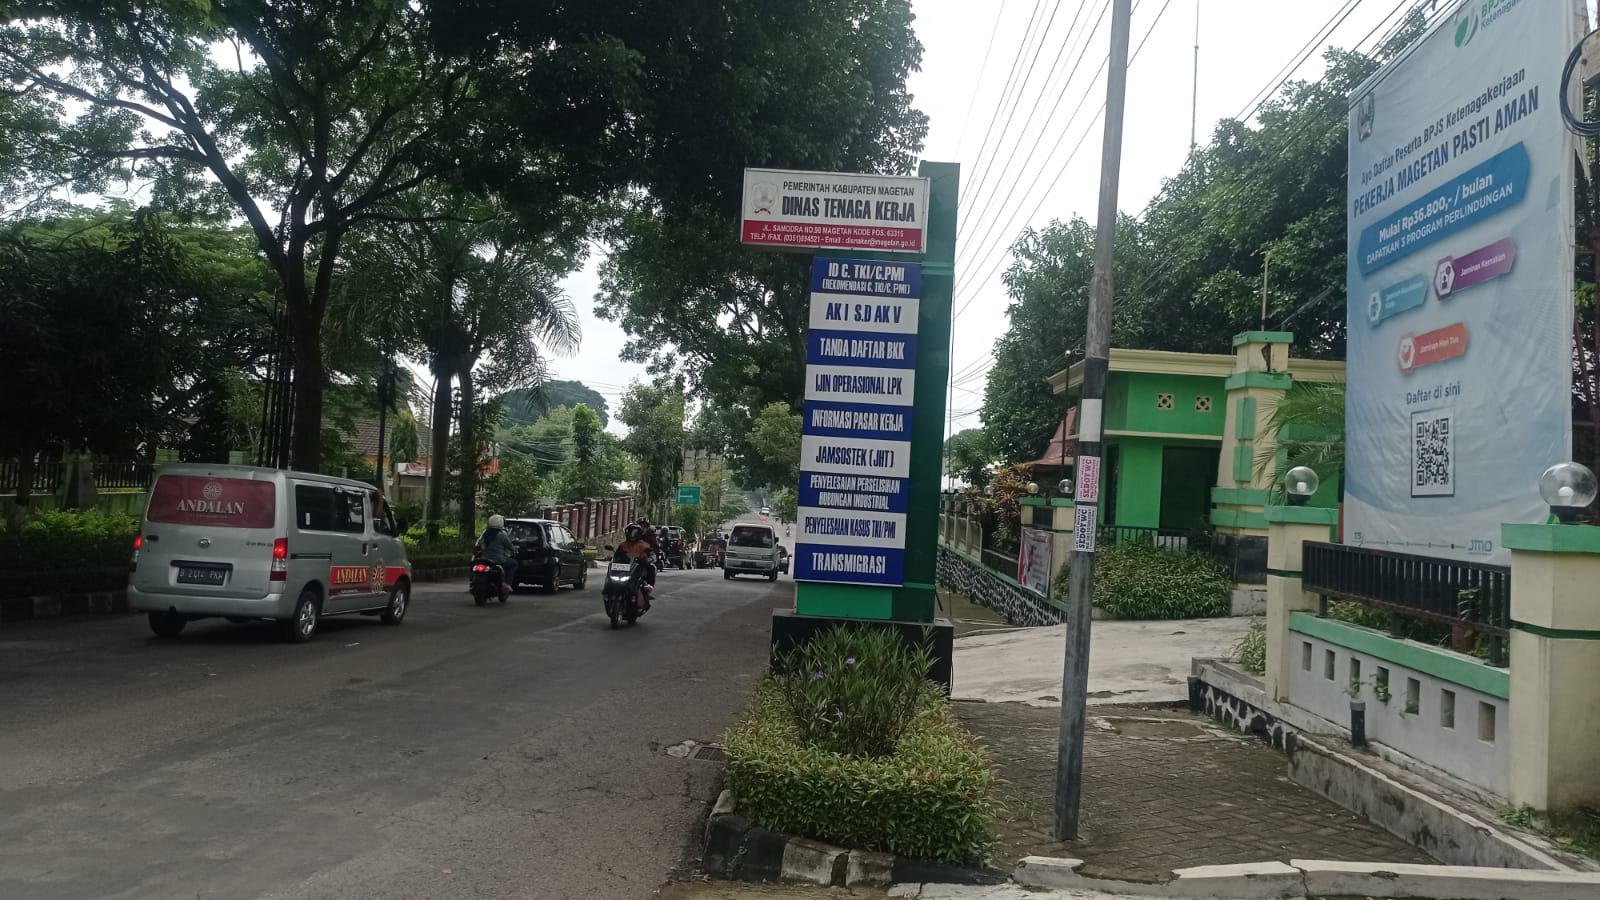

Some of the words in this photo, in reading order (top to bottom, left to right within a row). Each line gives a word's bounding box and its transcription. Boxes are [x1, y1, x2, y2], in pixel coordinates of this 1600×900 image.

[1482, 0, 1505, 18] BPJ
[1395, 136, 1422, 163] Peserta
[1424, 118, 1444, 143] BPJS
[1445, 68, 1525, 129] Ketenagakerjaan
[1353, 179, 1395, 218] PEKERJA
[1398, 141, 1449, 192] MAGETAN
[1453, 115, 1490, 158] PASTI
[1494, 85, 1539, 134] AMAN
[783, 181, 830, 193] PEMERINTAH
[832, 184, 876, 195] KABUPATEN
[878, 186, 915, 197] MAGETAN
[782, 195, 820, 217] DINAS
[824, 198, 871, 220] TENAGA
[875, 201, 915, 222] KERJA
[1379, 220, 1401, 243] Mulai
[1462, 173, 1493, 199] bulan
[822, 226, 852, 235] MAGETAN
[853, 228, 871, 236] KODE
[1366, 239, 1400, 265] DAPATKAN
[1400, 236, 1407, 247] 3
[1406, 220, 1443, 244] PROGRAM
[1444, 182, 1513, 228] PERLINDUNGAN
[828, 262, 839, 278] ID
[841, 263, 851, 278] C.
[853, 264, 905, 282] TKI/C.PMI
[825, 302, 842, 321] AK
[844, 303, 849, 321] I
[854, 303, 872, 322] S.D
[874, 304, 890, 323] AK
[893, 306, 902, 324] V
[820, 337, 849, 357] TANDA
[851, 339, 885, 359] DAFTAR
[886, 341, 905, 360] BKK
[815, 373, 831, 392] IJIN
[832, 374, 886, 394] OPERASIONAL
[887, 376, 902, 395] LPK
[1406, 389, 1432, 405] Daftar
[1433, 386, 1442, 399] di
[1444, 381, 1461, 397] sini
[811, 409, 852, 429] INFORMASI
[853, 411, 878, 431] PASAR
[879, 412, 904, 432] KERJA
[815, 445, 867, 467] JAMSOSTEK
[1084, 458, 1092, 471] WC
[810, 474, 856, 491] PENYELESAIAN
[857, 476, 901, 494] PERSELISIHAN
[1083, 472, 1091, 498] SEDOT
[176, 499, 245, 514] ANDALAN
[819, 491, 853, 507] HUBUNGAN
[853, 493, 889, 510] INDUSTRIAL
[1080, 508, 1088, 521] WC
[804, 516, 849, 536] PENYELESAIAN
[849, 518, 870, 537] KASUS
[871, 519, 897, 539] TKI/PMI
[812, 552, 886, 575] TRANSMIGRASI
[335, 568, 367, 584] ANDALAN
